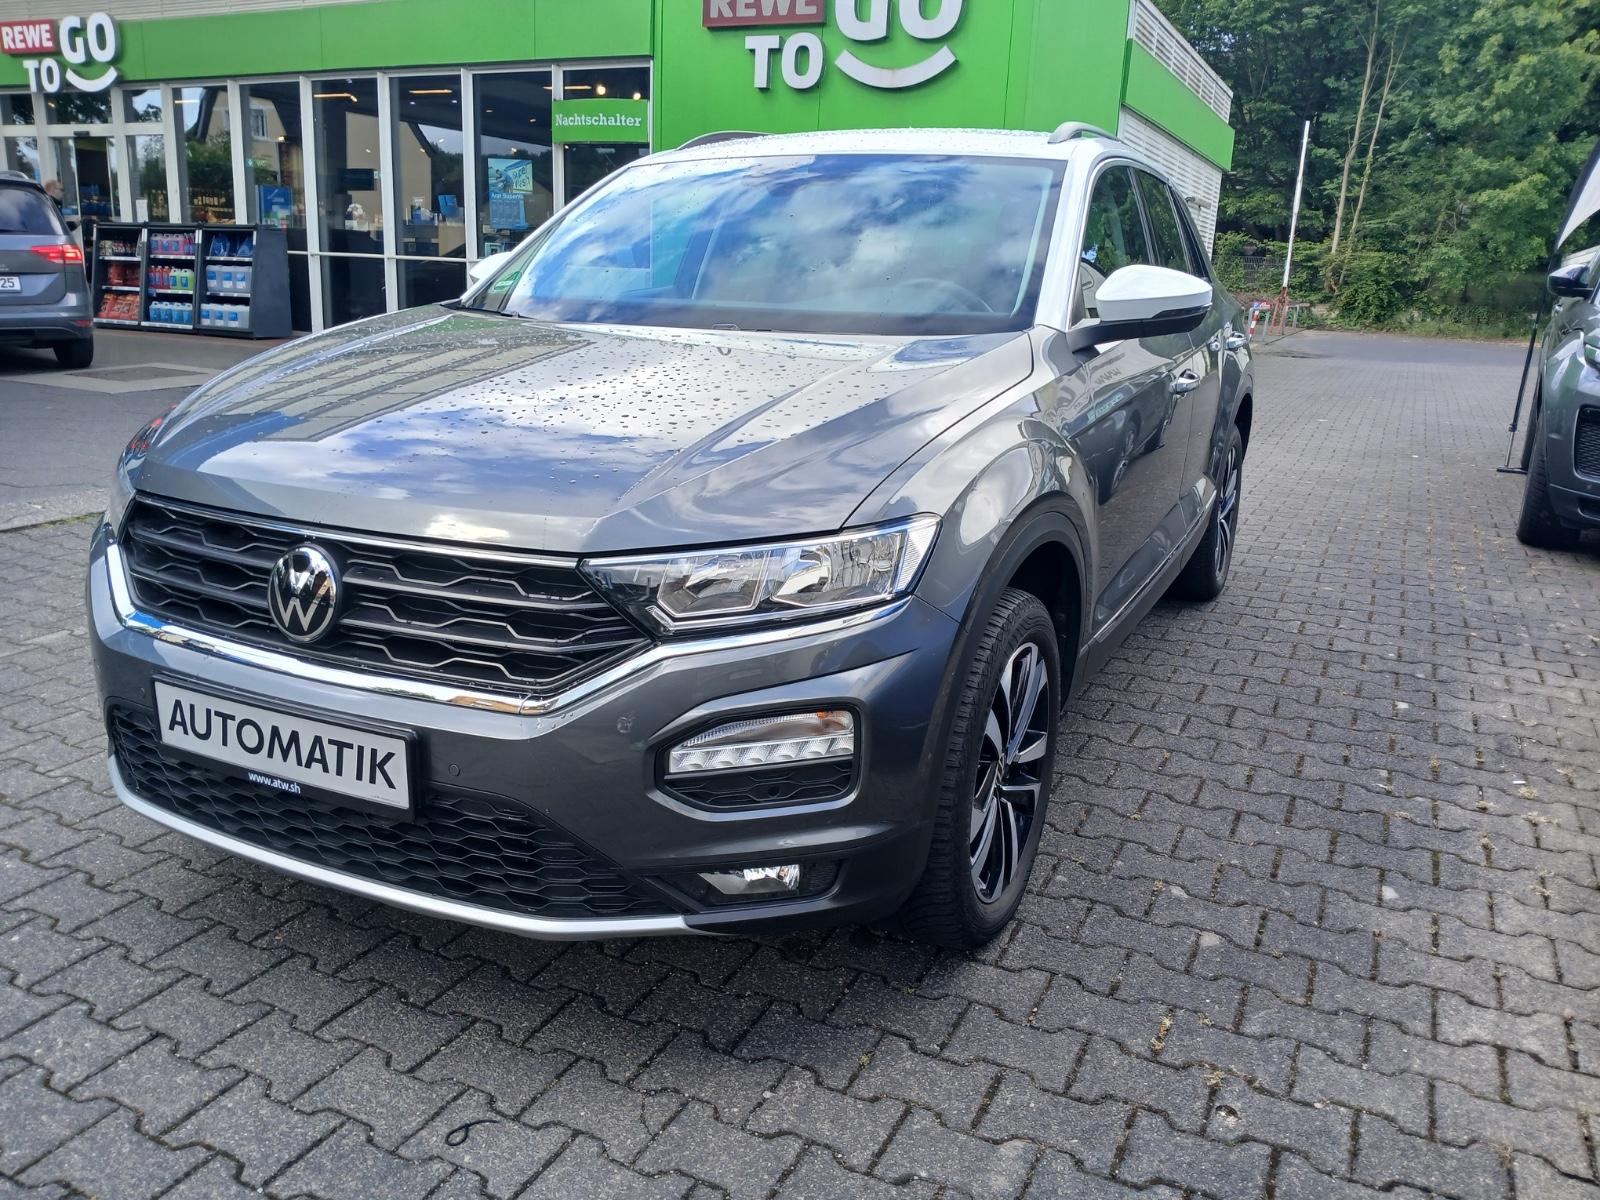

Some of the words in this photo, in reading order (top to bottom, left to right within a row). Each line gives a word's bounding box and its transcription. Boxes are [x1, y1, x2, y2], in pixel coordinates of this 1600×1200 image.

[1, 24, 53, 50] REWE
[59, 12, 116, 64] GO
[23, 58, 60, 93] TO
[745, 32, 824, 90] TO
[555, 113, 642, 127] Nachtschalter
[0, 277, 15, 288] 25
[168, 699, 396, 790] AUTOMATIK
[248, 772, 301, 794] www.atw.sh
